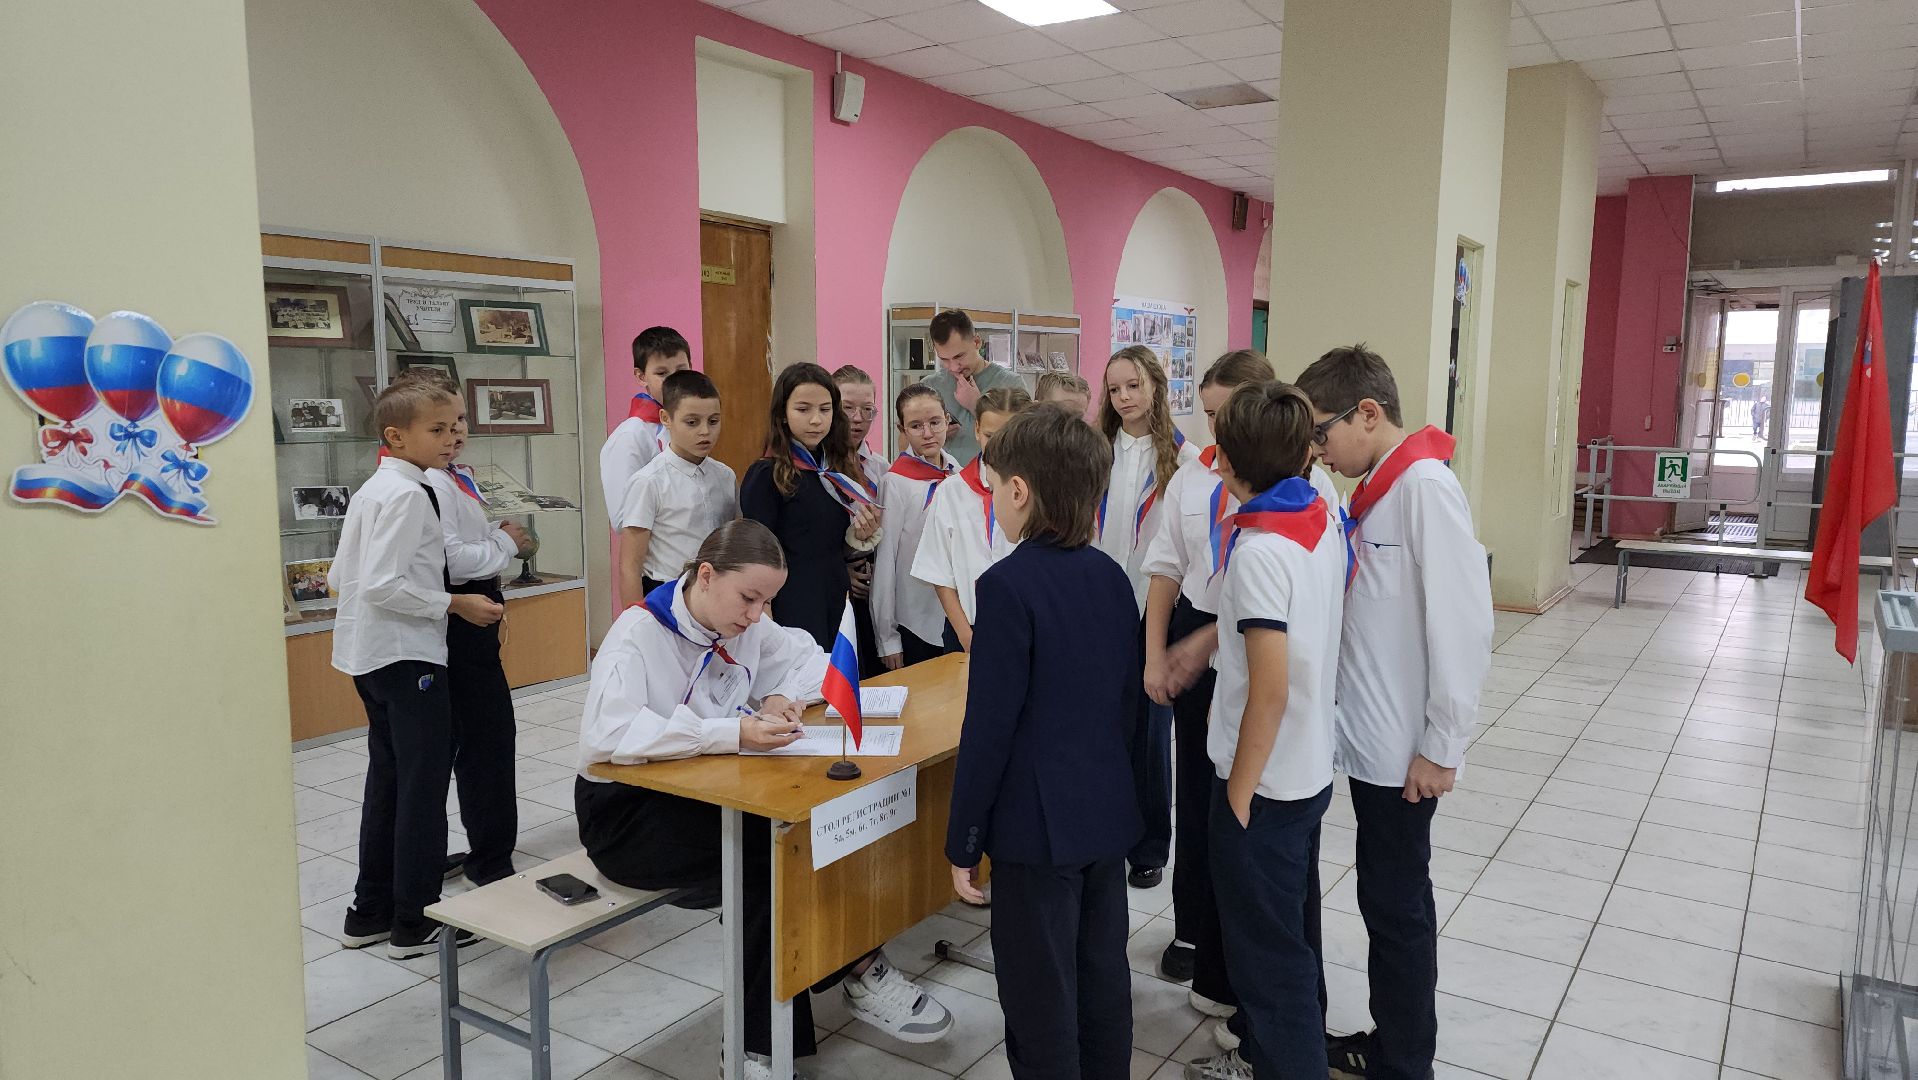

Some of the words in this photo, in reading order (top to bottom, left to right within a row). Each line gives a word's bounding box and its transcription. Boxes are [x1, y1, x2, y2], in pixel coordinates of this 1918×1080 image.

[816, 819, 840, 837] СТОЛ
[842, 792, 899, 826] РЕГИСТРАЦИИ
[901, 787, 911, 799] №1
